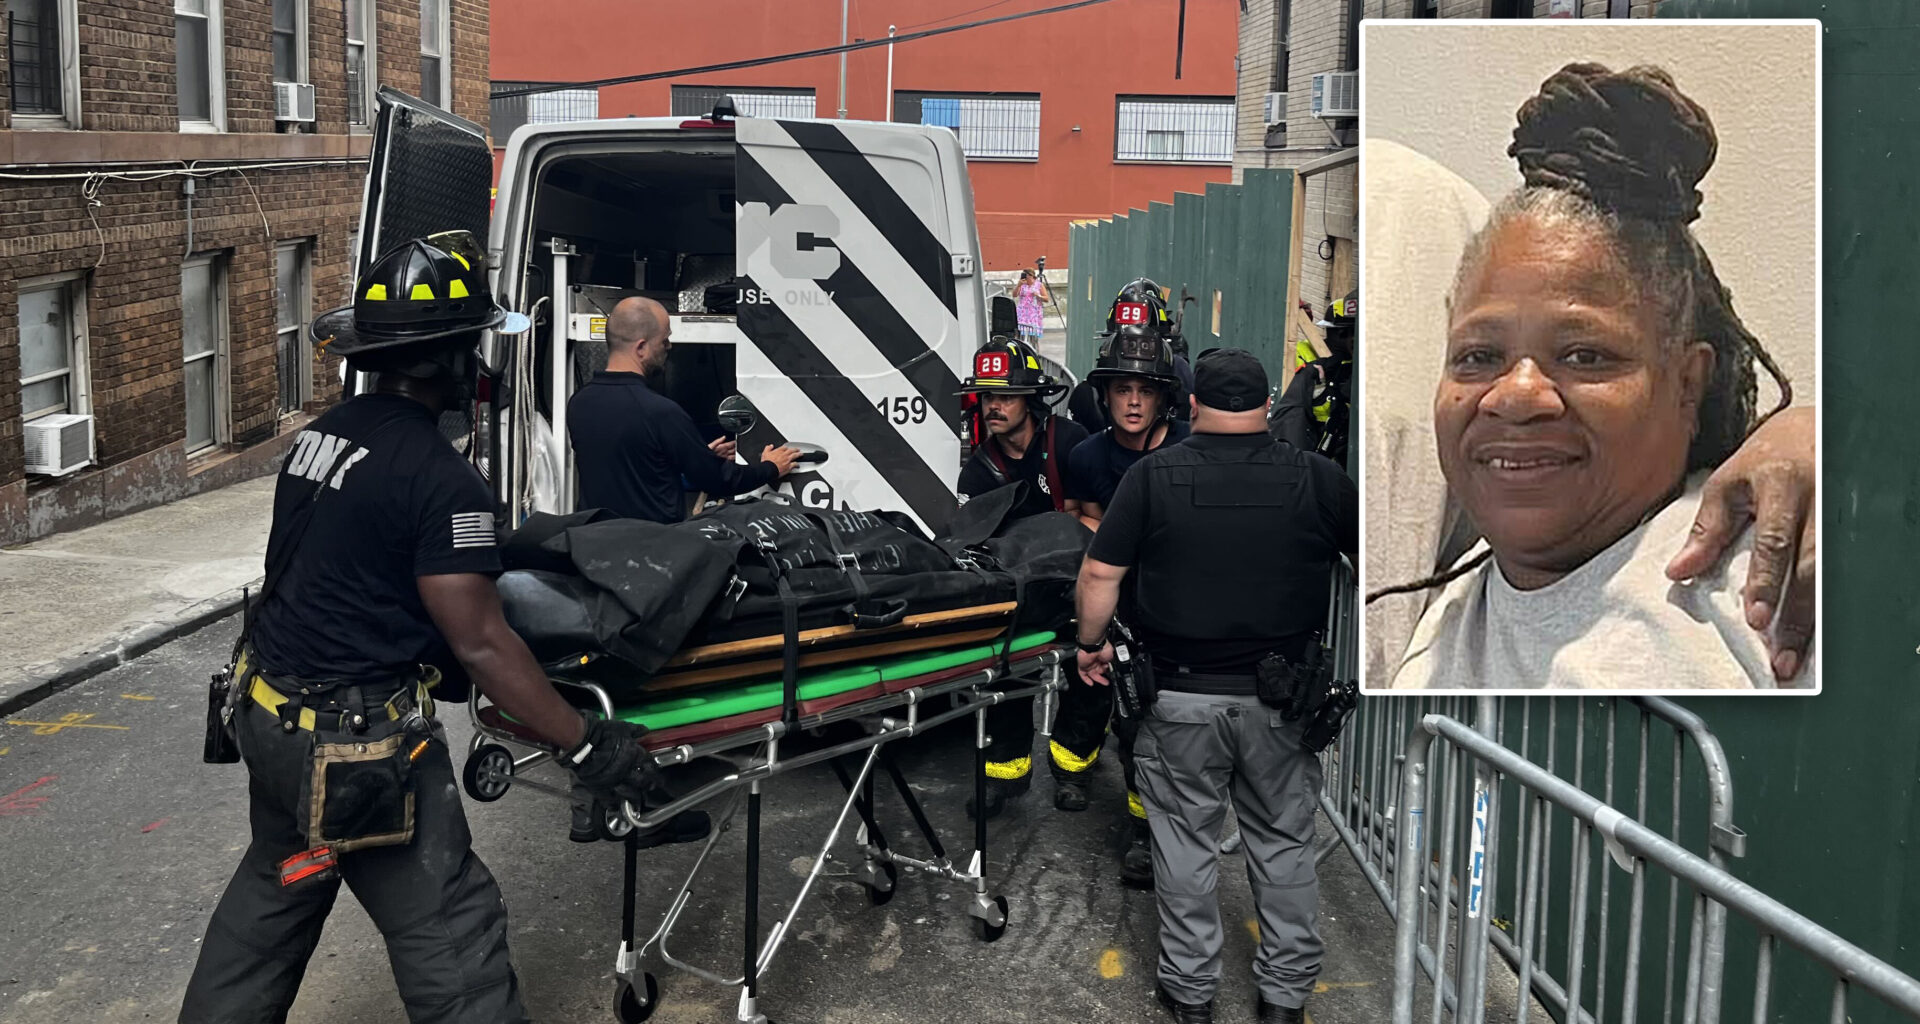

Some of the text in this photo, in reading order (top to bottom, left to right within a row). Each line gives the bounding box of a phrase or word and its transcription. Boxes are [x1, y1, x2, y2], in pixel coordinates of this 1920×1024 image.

[785, 290, 835, 306] ONLY
[1122, 306, 1141, 320] 29
[981, 357, 1002, 373] 29
[877, 395, 927, 425] 159
